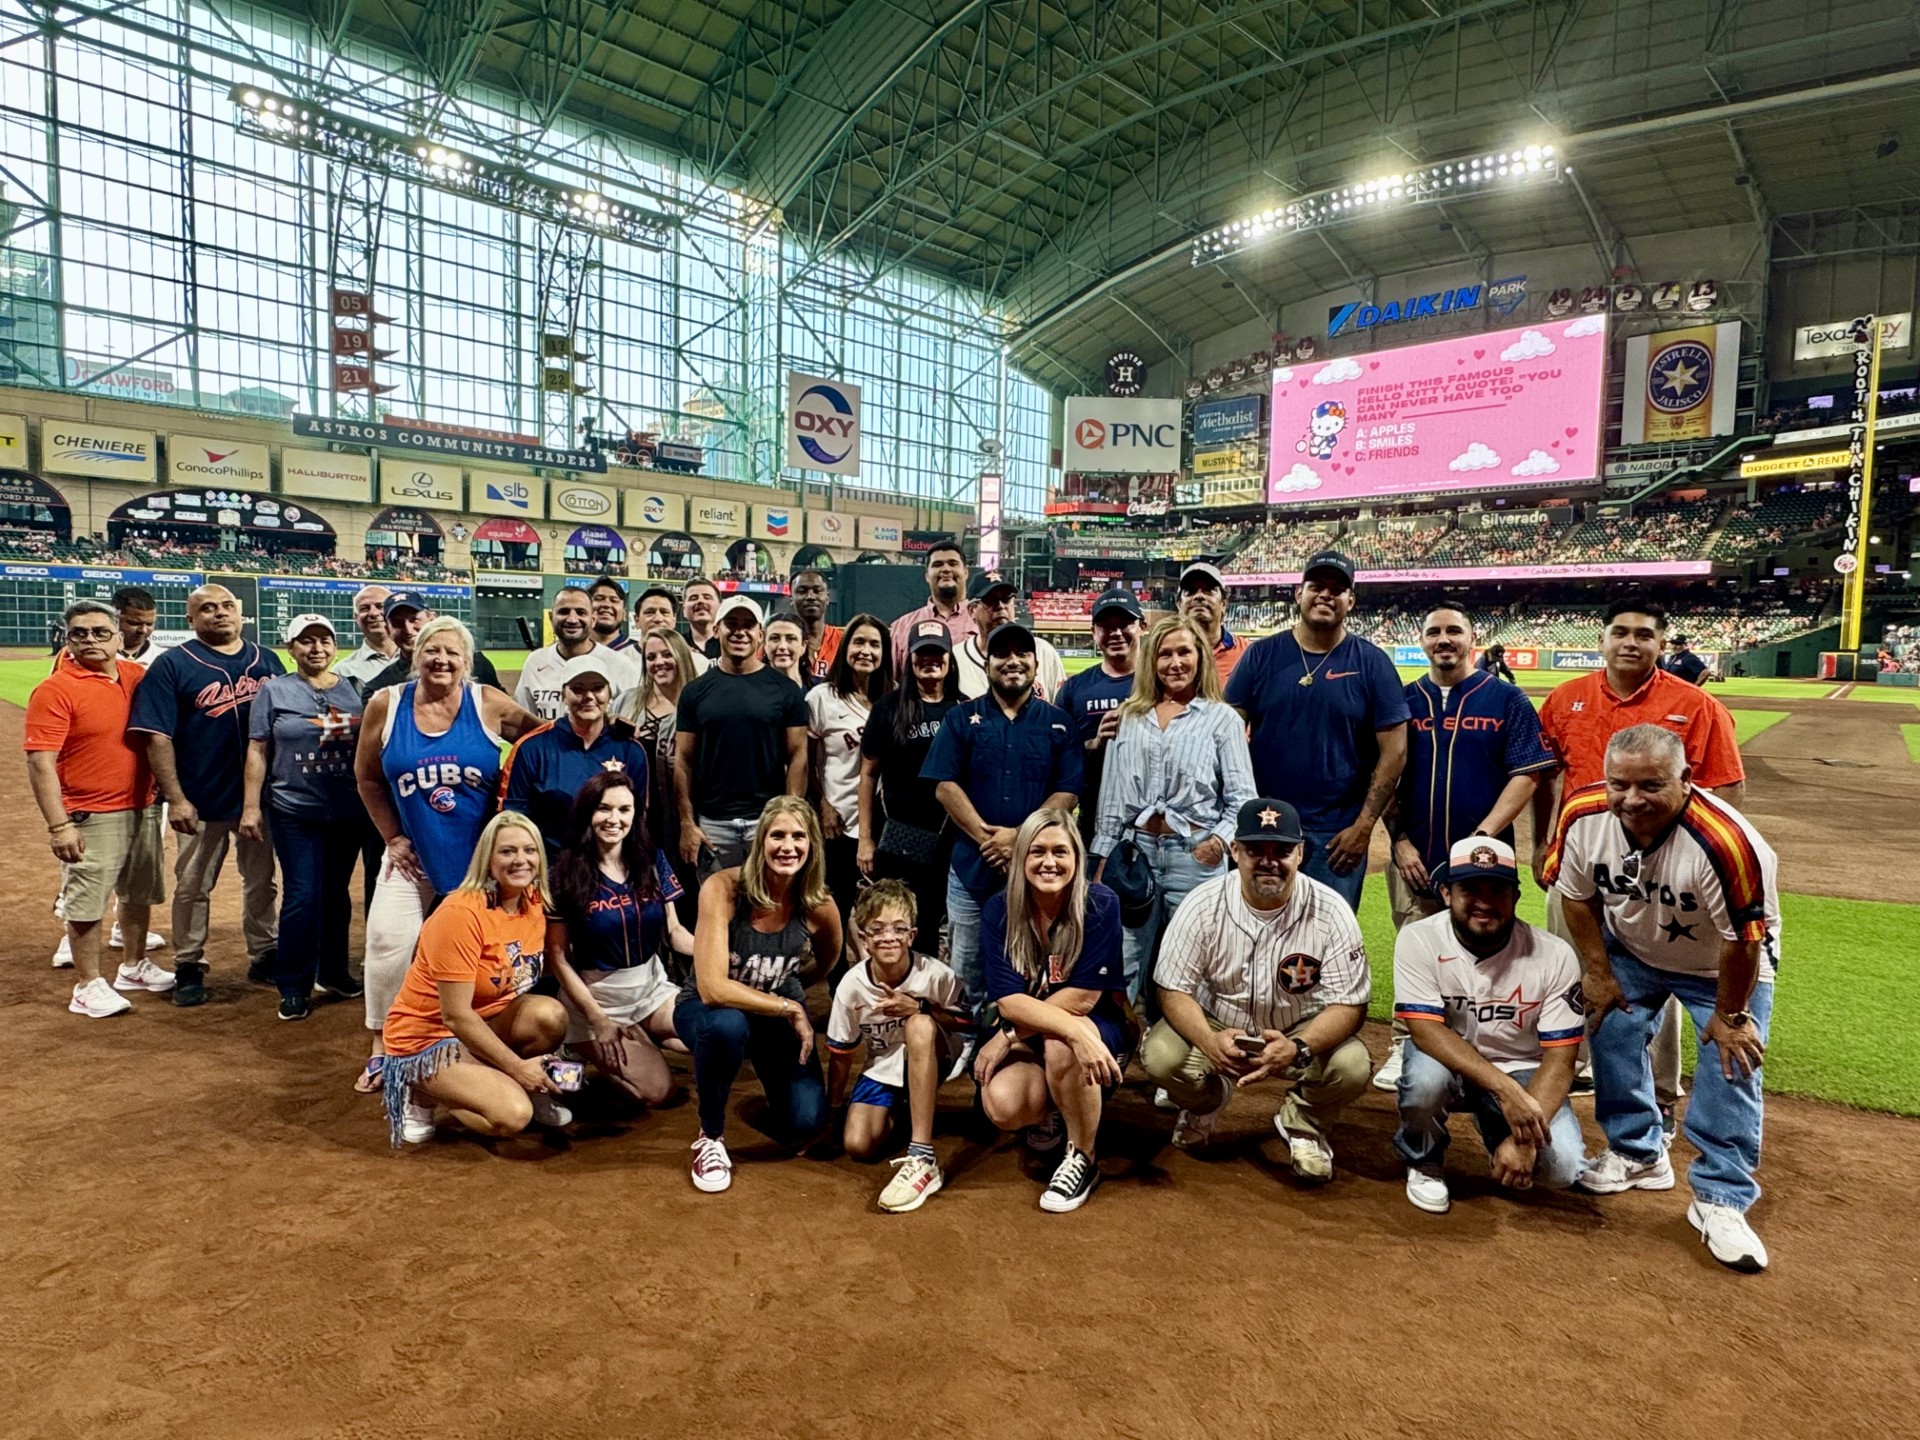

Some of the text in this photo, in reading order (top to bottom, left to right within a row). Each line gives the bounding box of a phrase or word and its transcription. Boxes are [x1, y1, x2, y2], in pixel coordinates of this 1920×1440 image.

[1580, 285, 1605, 303] 24
[1622, 284, 1634, 300] 5
[1659, 281, 1673, 299] 7
[1691, 279, 1715, 298] 13
[340, 296, 361, 310] 05
[1357, 280, 1526, 327] DAIKIN PARK
[342, 335, 362, 348] 19
[1804, 328, 1852, 344] Texas
[551, 340, 565, 351] 17
[1836, 344, 1860, 352] CREDI
[1655, 348, 1707, 372] ESTRELLA
[342, 370, 361, 382] 21
[550, 374, 565, 385] 22
[1117, 366, 1133, 381] H
[1358, 366, 1514, 396] FINISH THIS FAMOUS
[1357, 393, 1401, 405] HELLO
[1407, 385, 1449, 398] KITTY
[1455, 377, 1513, 391] QUOTE:
[1357, 384, 1523, 413] CAN NEVER HAVE TOO
[1657, 390, 1702, 407] JALISCO
[795, 411, 855, 438] OXY
[1199, 410, 1254, 429] Methodist
[1357, 410, 1397, 423] MANY
[1109, 423, 1175, 448] PNC
[1356, 422, 1416, 439] A: APPLES
[53, 434, 147, 455] CHENIERE
[309, 420, 598, 468] ASTROS COMMUNITY LEADERS
[1356, 435, 1413, 450] B: SMILES
[1355, 446, 1419, 461] C: FRIENDS
[176, 461, 264, 480] ConocoPhillips
[287, 467, 367, 482] HALLIBURTON
[391, 487, 453, 501] LEXUS
[503, 481, 529, 498] slb
[565, 493, 604, 511] COTTON
[644, 506, 665, 514] OXY
[699, 506, 736, 522] reliant
[1481, 510, 1548, 526] Silverado
[1843, 474, 1861, 550] CHIKIN
[1378, 520, 1416, 532] Chevy
[581, 530, 607, 539] planet
[903, 540, 932, 550] Budw
[1064, 548, 1143, 558] impact impact
[5, 566, 48, 575] GEICO
[81, 569, 123, 579] GEICO
[152, 574, 190, 582] GEICO
[152, 633, 187, 642] botham
[1556, 656, 1607, 668] Methodi
[195, 673, 277, 709] Astro
[533, 690, 561, 702] STR
[1086, 698, 1118, 711] FIND
[1461, 716, 1504, 732] CITY
[295, 750, 352, 761] HOUST
[302, 763, 347, 774] ASTR
[397, 763, 482, 798] CUBS
[1593, 863, 1699, 912] Asros
[588, 893, 632, 914] PACE
[1349, 945, 1365, 962] AST
